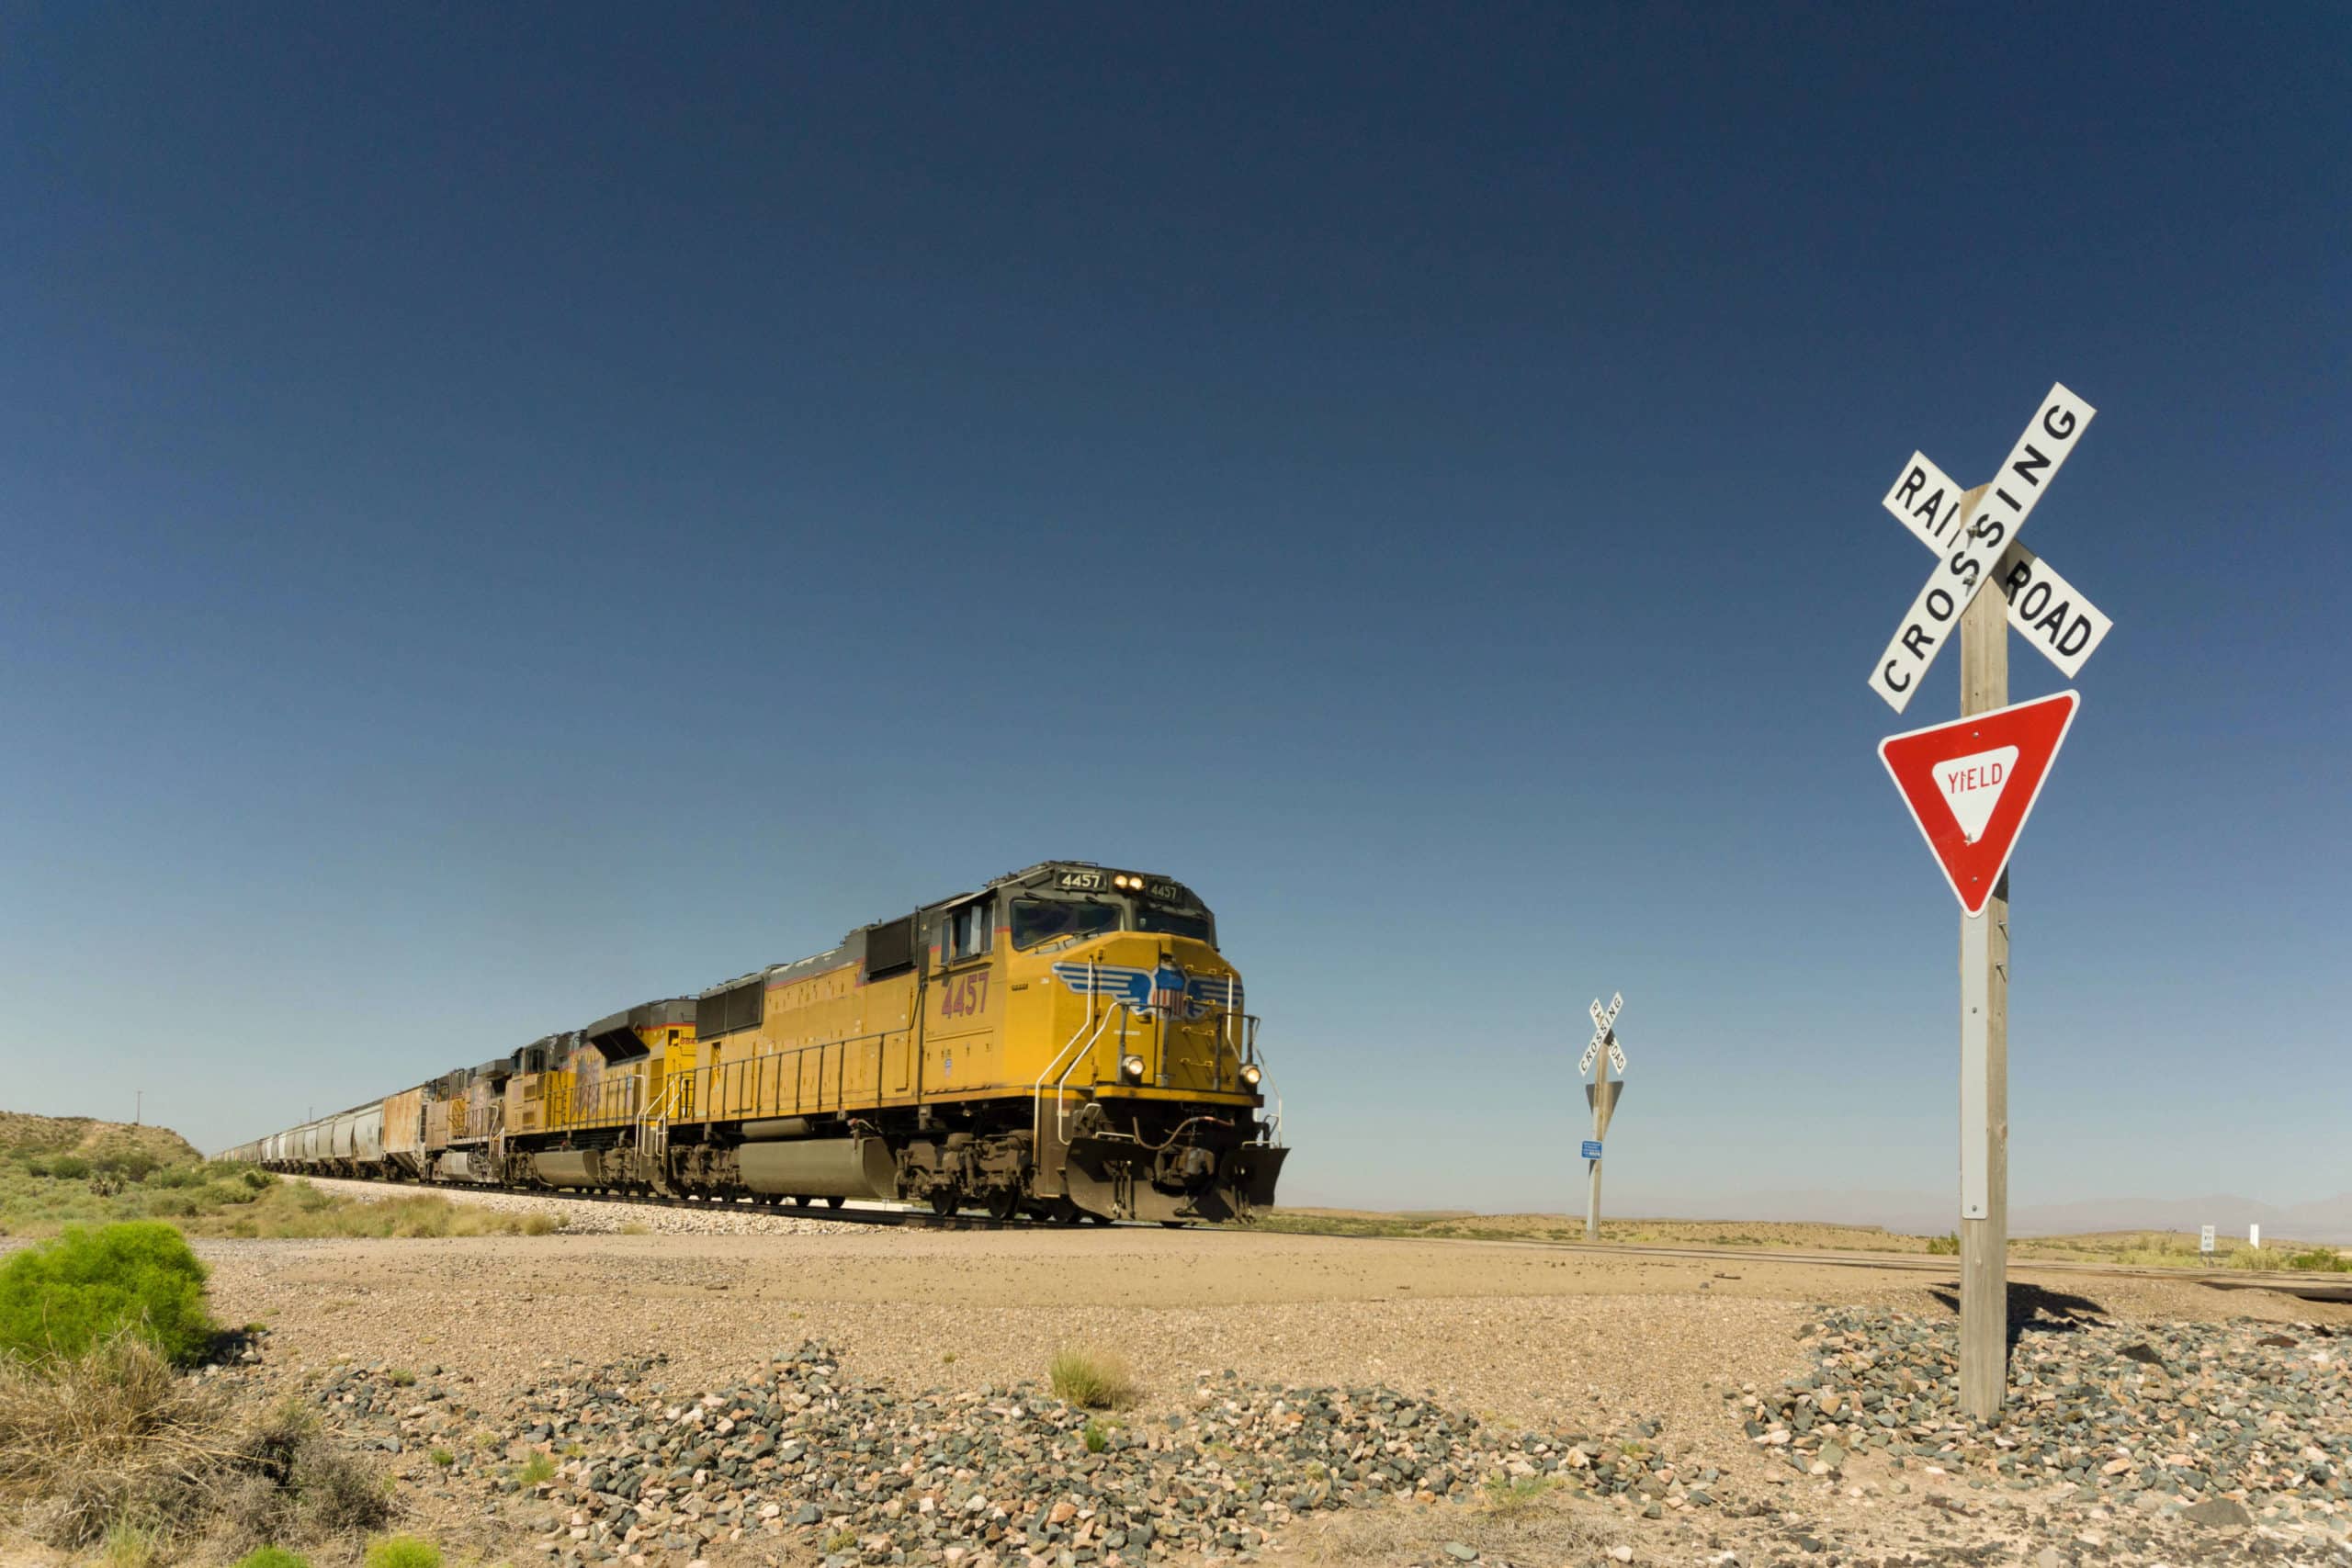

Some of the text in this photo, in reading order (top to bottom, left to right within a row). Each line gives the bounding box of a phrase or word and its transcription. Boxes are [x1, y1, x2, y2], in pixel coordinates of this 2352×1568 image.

[1884, 405, 2076, 693] CROSSING
[2007, 560, 2092, 657] ROAD
[1948, 763, 2003, 794] YIELD
[1061, 874, 1100, 888] 4457
[1151, 885, 1177, 900] 4457
[942, 971, 989, 1019] 4457
[1581, 998, 1621, 1071] CROSSING
